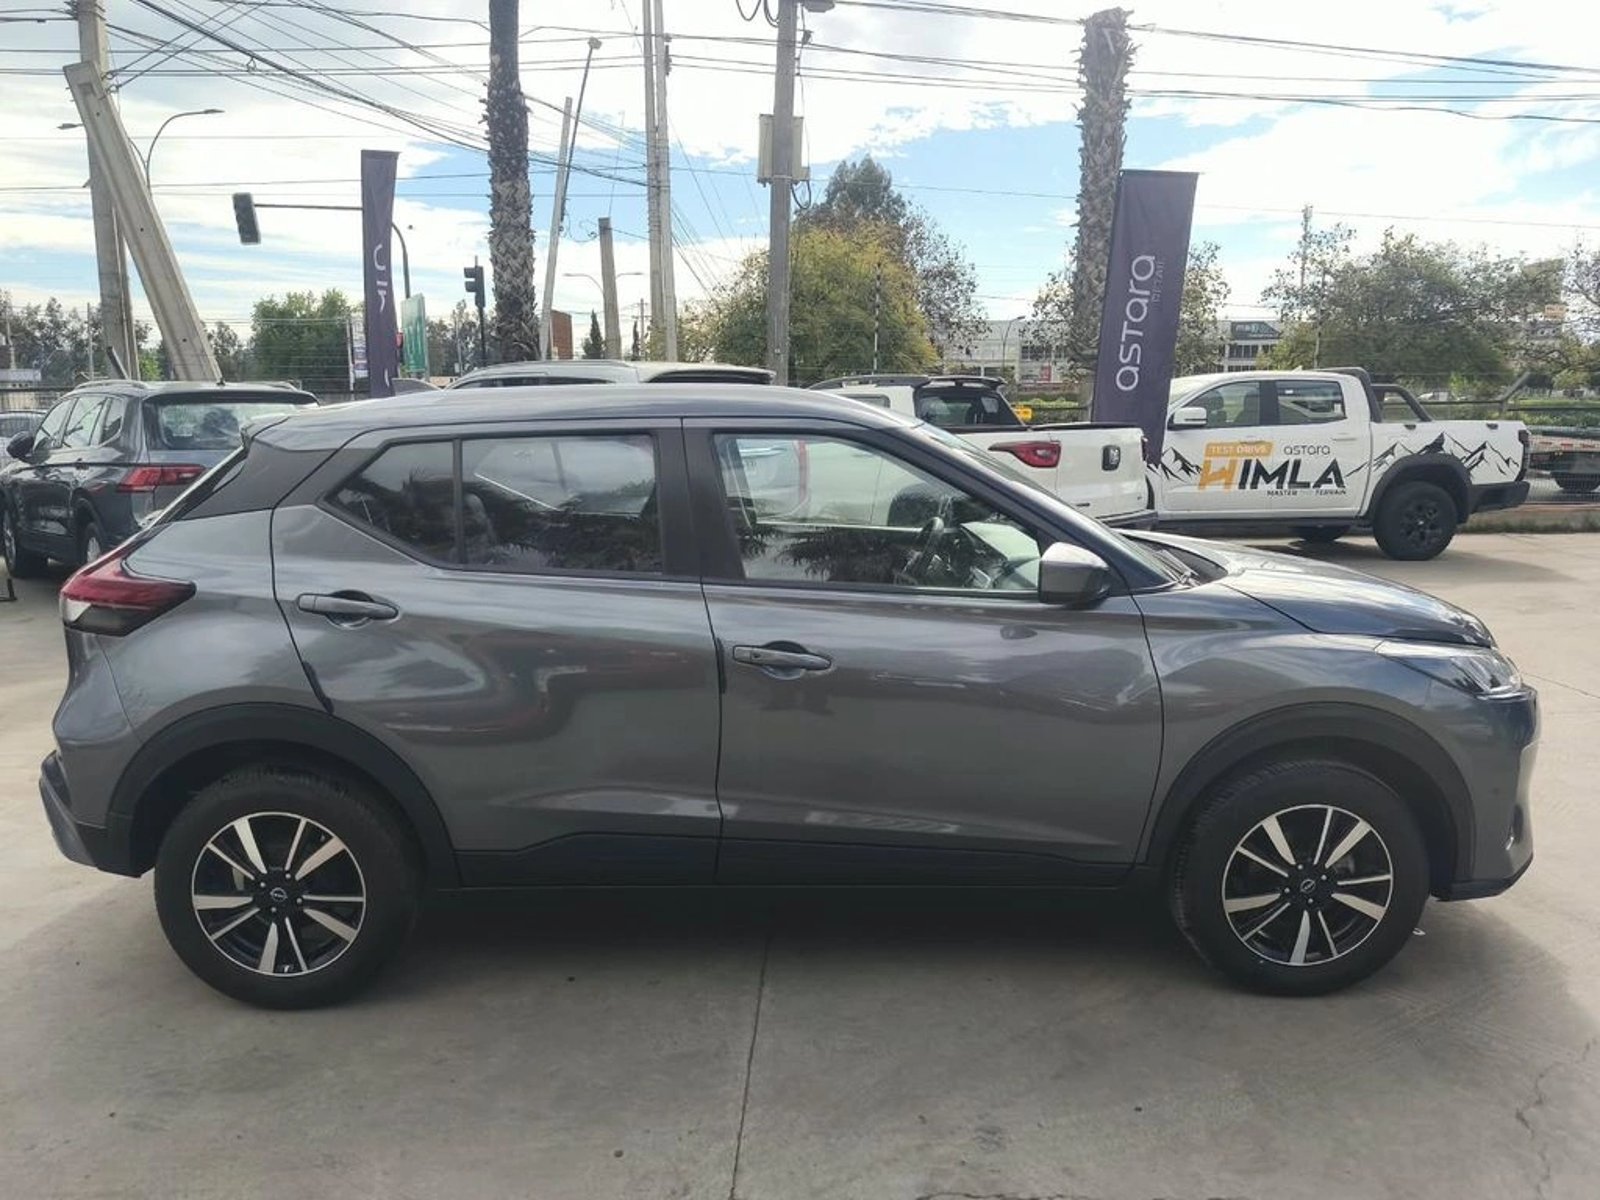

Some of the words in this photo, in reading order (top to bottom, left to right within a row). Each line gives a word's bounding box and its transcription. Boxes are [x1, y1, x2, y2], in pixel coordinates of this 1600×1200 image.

[1116, 254, 1156, 391] astara
[1211, 445, 1234, 455] TEST
[1236, 445, 1267, 455] DRIVE
[1283, 444, 1331, 456] astara
[1198, 458, 1346, 491] HIMLA
[1266, 489, 1298, 497] MASTER
